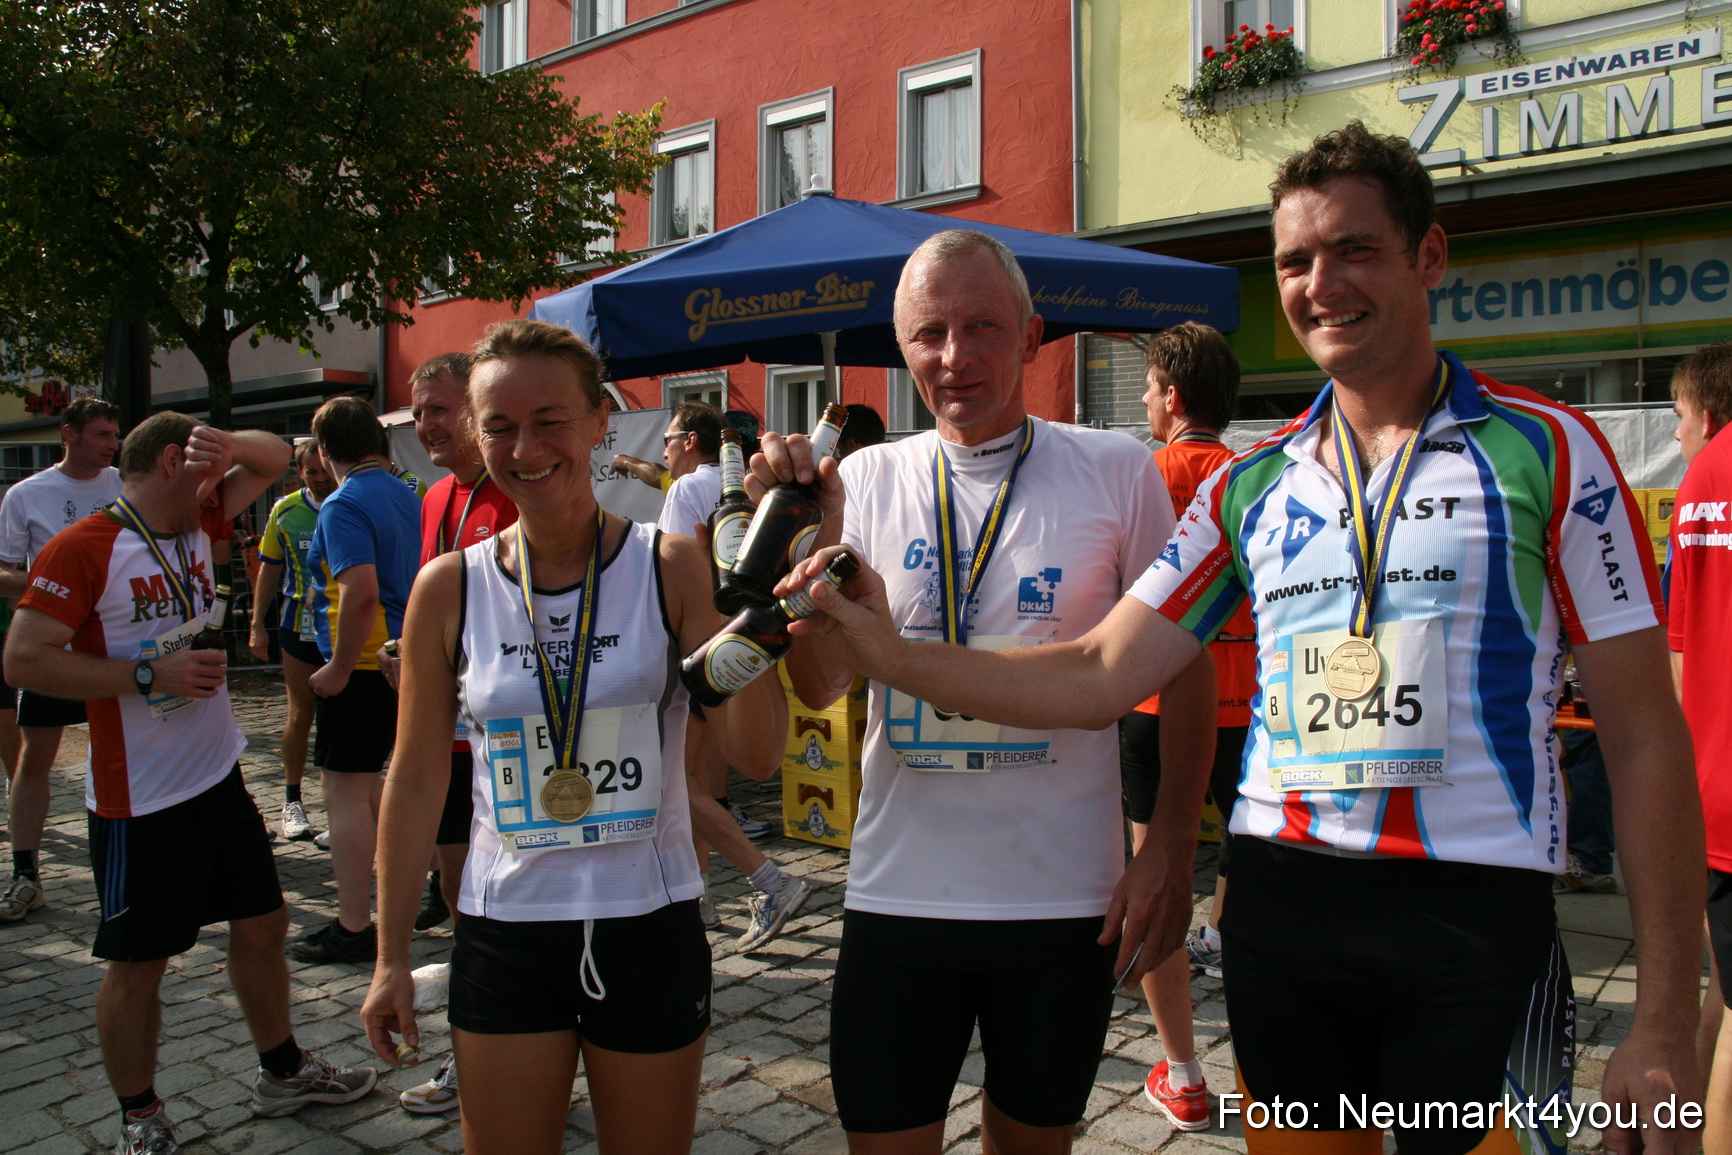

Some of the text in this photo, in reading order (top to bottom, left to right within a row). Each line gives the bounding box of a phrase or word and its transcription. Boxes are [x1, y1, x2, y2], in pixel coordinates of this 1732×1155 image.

[1482, 37, 1701, 95] EISENWAREN
[1397, 64, 1732, 172] ZIMME
[684, 272, 876, 342] Glossner-Bier
[1115, 286, 1209, 318] Biergenuss
[1339, 497, 1461, 529] PAST
[1678, 501, 1729, 526] MAX
[903, 538, 933, 570] 6.
[1598, 532, 1628, 601] PLAST
[1265, 565, 1456, 602] www.tr-pst.de
[1019, 601, 1052, 613] DKMS
[163, 634, 194, 655] Stefan
[519, 635, 620, 656] INTERORT
[522, 649, 603, 669] LNE
[1269, 695, 1279, 717] B
[1306, 684, 1423, 733] 2645
[535, 725, 549, 750] E
[904, 754, 942, 765] BOCK
[986, 750, 1048, 763] PFLEIDERER
[1366, 760, 1443, 775] PFLEIDERER
[503, 767, 513, 785] B
[543, 757, 643, 794] 29
[1280, 769, 1323, 783] BOCK
[601, 817, 656, 834] PFLEIDERER
[516, 832, 559, 845] BOCK
[1561, 995, 1576, 1068] PLAST
